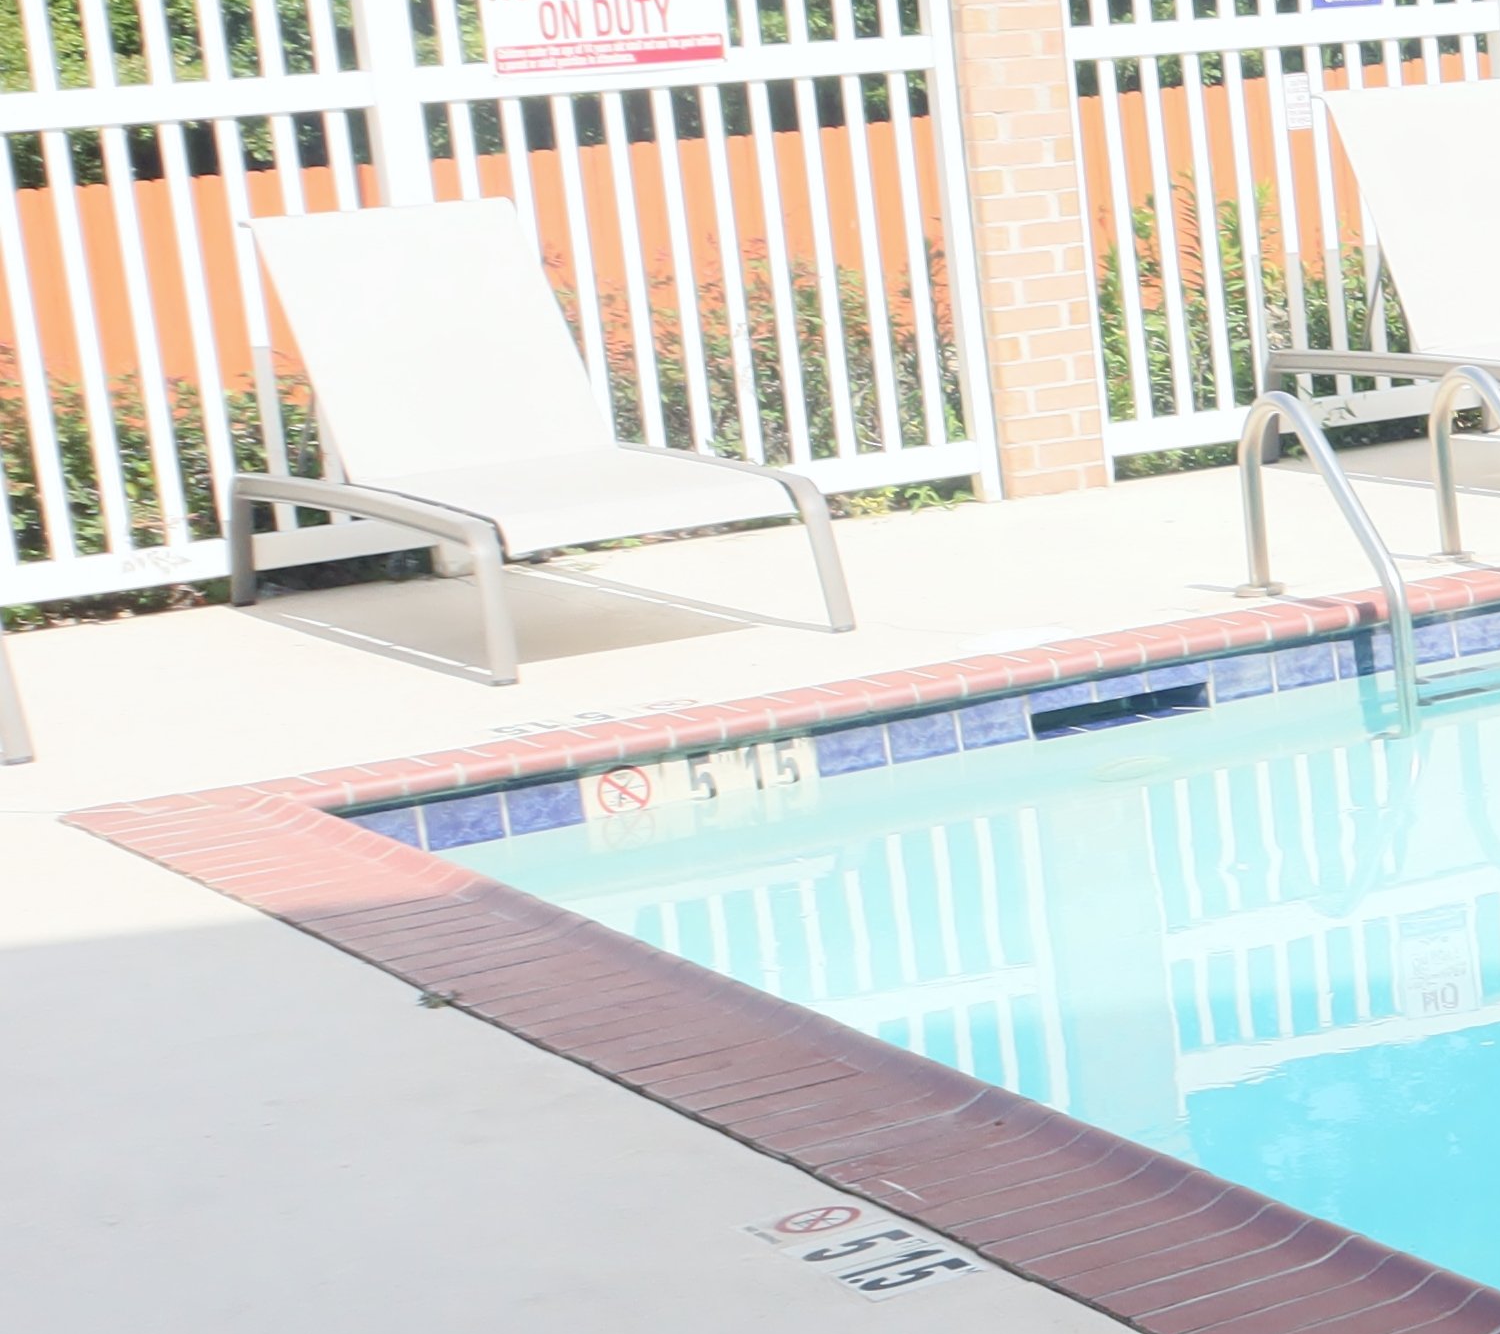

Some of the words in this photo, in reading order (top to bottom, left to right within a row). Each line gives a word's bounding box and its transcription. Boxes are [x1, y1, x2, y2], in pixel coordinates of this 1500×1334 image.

[538, 0, 582, 40] ON
[685, 753, 718, 799] 5
[802, 1229, 914, 1262] 5
[838, 1248, 972, 1292] 1.5
